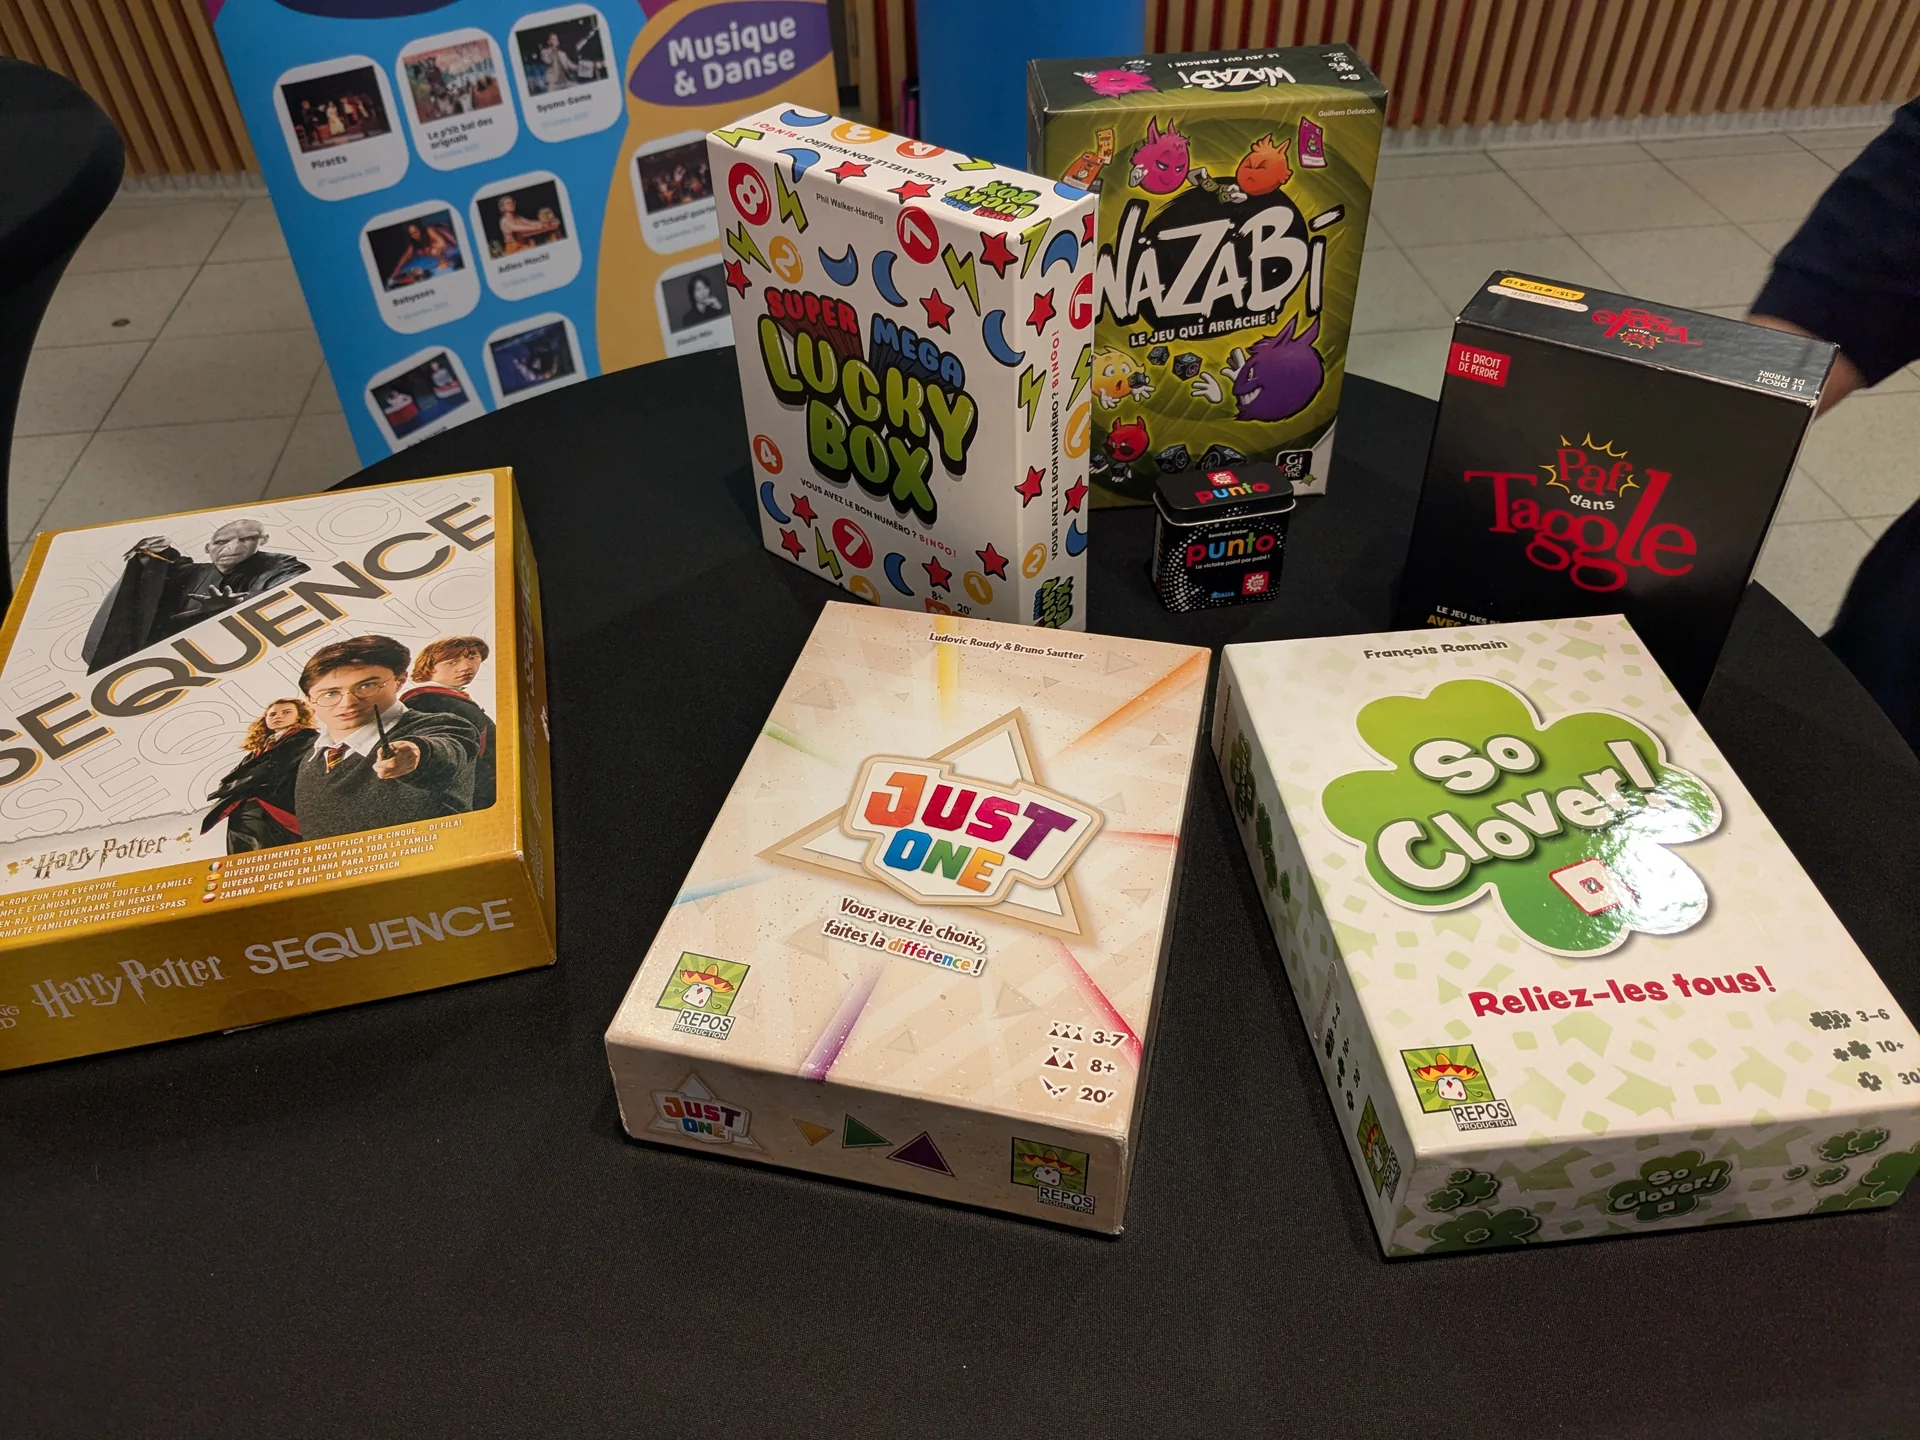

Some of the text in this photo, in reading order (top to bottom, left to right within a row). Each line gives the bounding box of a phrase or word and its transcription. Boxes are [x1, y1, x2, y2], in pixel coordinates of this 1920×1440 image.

[668, 15, 797, 67] Musique
[672, 47, 797, 98] & Danse
[477, 117, 493, 128] des
[1318, 108, 1376, 117] Guilhem Debricon
[850, 151, 872, 162] BON
[885, 163, 914, 175] AVEZ
[915, 172, 947, 186] VOUS
[978, 181, 1040, 204] BOX
[816, 193, 884, 224] Phil Walker-Harding
[945, 186, 1039, 218] LUCKY
[765, 289, 858, 334] SUPER
[1131, 334, 1145, 346] LE
[1150, 329, 1175, 342] JEU
[1208, 314, 1266, 333] ARRACHE
[873, 317, 963, 387] MEGA
[1461, 351, 1501, 369] LE DROIT
[1459, 362, 1499, 380] DE PERDRE
[1755, 377, 1788, 388] DROIT
[1758, 370, 1805, 386] DE PERDRE
[760, 317, 975, 462] LUCKY
[808, 399, 934, 512] BOX
[1556, 448, 1632, 498] Paf
[1052, 480, 1059, 495] LE
[1195, 482, 1270, 504] punto
[1051, 498, 1059, 526] AVEZ
[1570, 494, 1615, 512] dans
[800, 478, 822, 494] VOUS
[824, 490, 843, 505] AVEZ
[845, 498, 854, 509] LE
[855, 504, 872, 518] BON
[919, 534, 957, 557] BINGO!
[1464, 468, 1697, 592] Taggle
[1051, 530, 1059, 561] VOUS
[1208, 530, 1231, 538] Bernhard
[1186, 532, 1275, 568] punto
[1203, 561, 1225, 569] victoire
[1226, 558, 1240, 566] point
[932, 591, 943, 601] 8+
[957, 604, 971, 615] 20'
[1436, 605, 1448, 615] LE
[1450, 610, 1468, 619] JEU
[1469, 614, 1487, 624] DES
[0, 501, 495, 788] SEQUENCE
[929, 633, 1084, 660] Ludovic Roudy & Bruno Sautter
[1363, 640, 1508, 660] François Romain
[1411, 737, 1539, 793] So
[863, 771, 1077, 862] JUST
[1375, 739, 1668, 890] Clover!
[224, 834, 438, 878] DIVERTIDO CINCO EN RAYA PARA TODA LA FAMILIA
[237, 848, 300, 865] DIVERTIMENTO
[315, 837, 364, 851] MOLTIPLICA
[367, 834, 383, 842] PER
[440, 819, 462, 828] FILA!
[32, 835, 168, 880] Harry Potter
[268, 870, 294, 880] CINCO
[298, 867, 310, 875] EM
[313, 862, 338, 872] LINHA
[342, 857, 364, 867] PARA
[367, 853, 388, 862] TODA
[400, 845, 434, 856] FAMÍLIA
[882, 828, 1004, 892] ONE
[32, 893, 49, 902] FUN
[52, 889, 69, 898] FOR
[72, 880, 118, 895] EVERYONE
[220, 887, 256, 899] ZABAWA
[326, 871, 342, 880] DLA
[345, 860, 400, 876] WSZYSTKICH
[27, 905, 38, 913] ET
[40, 897, 87, 911] AMUSANT
[85, 893, 109, 902] POUR
[112, 887, 140, 898] TOUTE
[142, 884, 153, 892] LA
[156, 877, 194, 890] FAMILLE
[32, 912, 55, 922] VOOR
[58, 902, 110, 917] TOVENAARS
[114, 900, 125, 908] EN
[128, 893, 163, 906] HEKSEN
[36, 900, 187, 933] FAMILIEN-STRATEGIESPIEL-SPASS
[840, 898, 983, 951] Vous avez le choix,
[244, 900, 514, 976] SEQUENCE
[824, 919, 868, 943] faites
[870, 932, 886, 948] la
[888, 937, 971, 971] différence
[32, 972, 122, 1018] Harry
[119, 954, 232, 1005] Potter
[1468, 966, 1777, 1017] Reliez-les tous!
[673, 1024, 727, 1040] PRODUCTION
[678, 1010, 732, 1032] REPOS
[1092, 1031, 1124, 1047] 3-7
[1876, 1040, 1904, 1053] 10+
[1090, 1059, 1115, 1073] 8+
[1080, 1087, 1114, 1103] 20'
[663, 1096, 741, 1127] JUST
[1453, 1102, 1510, 1123] REPOS
[1458, 1118, 1516, 1131] PRODUCTION
[682, 1118, 726, 1139] ONE
[1614, 1169, 1721, 1209] Clover!
[1648, 1168, 1690, 1186] So
[1039, 1199, 1093, 1214] PRODUCTION
[1040, 1186, 1093, 1208] REPOS
